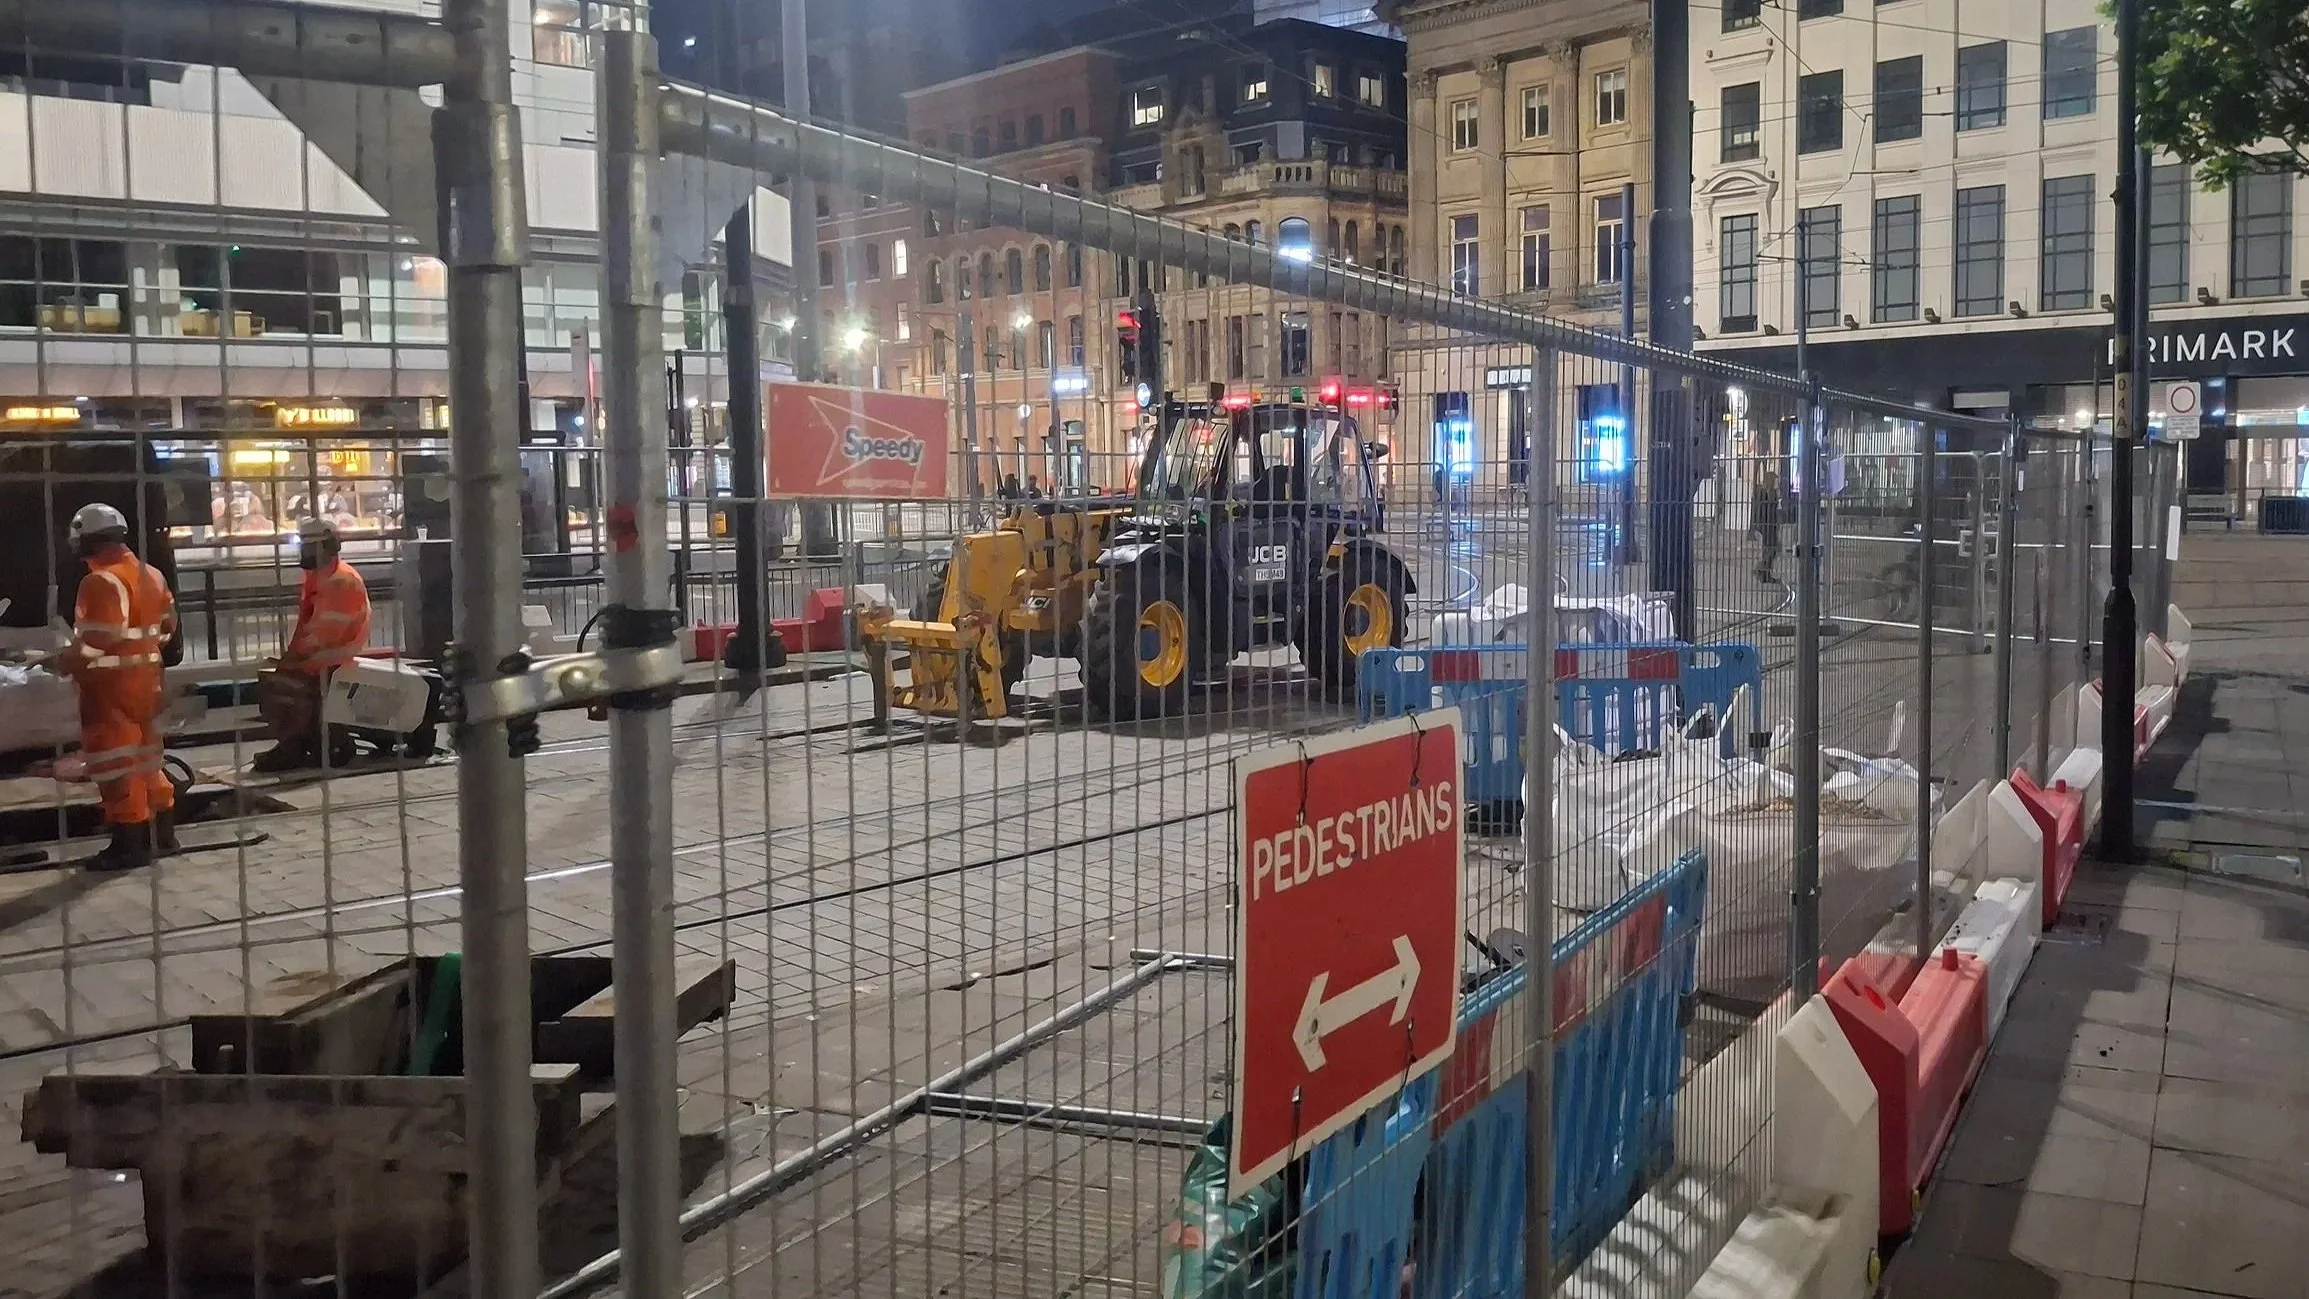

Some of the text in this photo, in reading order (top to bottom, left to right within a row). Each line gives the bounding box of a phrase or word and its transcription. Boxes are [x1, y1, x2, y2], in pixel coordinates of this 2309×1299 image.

[2107, 328, 2295, 365] IMARK
[841, 425, 925, 466] Speedy
[1248, 545, 1286, 563] JCB
[1252, 780, 1453, 901] PEDESTRIANS
